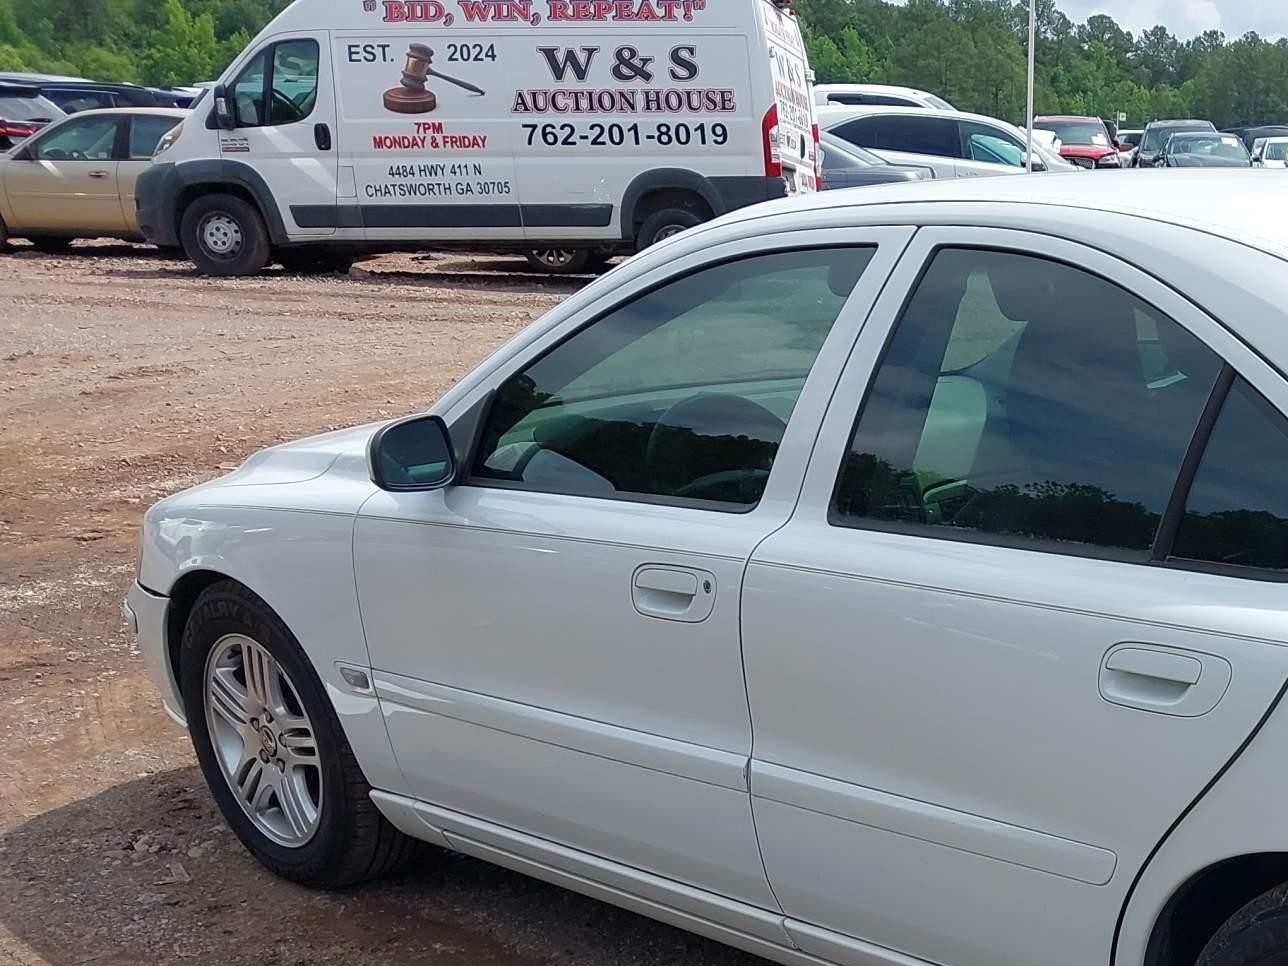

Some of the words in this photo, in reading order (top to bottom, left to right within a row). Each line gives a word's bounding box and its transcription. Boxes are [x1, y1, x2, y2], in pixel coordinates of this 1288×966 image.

[458, 0, 541, 26] WIN,
[547, 0, 706, 21] REPEAT!"
[348, 44, 394, 62] EST.
[446, 43, 497, 62] 2024
[536, 46, 600, 82] W
[610, 45, 655, 83] &
[668, 45, 699, 82] S
[511, 89, 637, 113] AUCTION
[642, 89, 736, 112] HOUSE
[414, 122, 443, 134] 7PM
[522, 123, 728, 146] 762-201-8019
[372, 136, 426, 149] MONDAY
[430, 136, 439, 149] &
[443, 136, 487, 149] FRIDAY
[388, 165, 415, 178] 4484
[418, 164, 446, 177] HWY
[450, 164, 469, 176] 411
[474, 163, 482, 175] N
[365, 183, 450, 197] CHATSWORTH
[455, 183, 473, 196] GA
[477, 181, 510, 195] 30705
